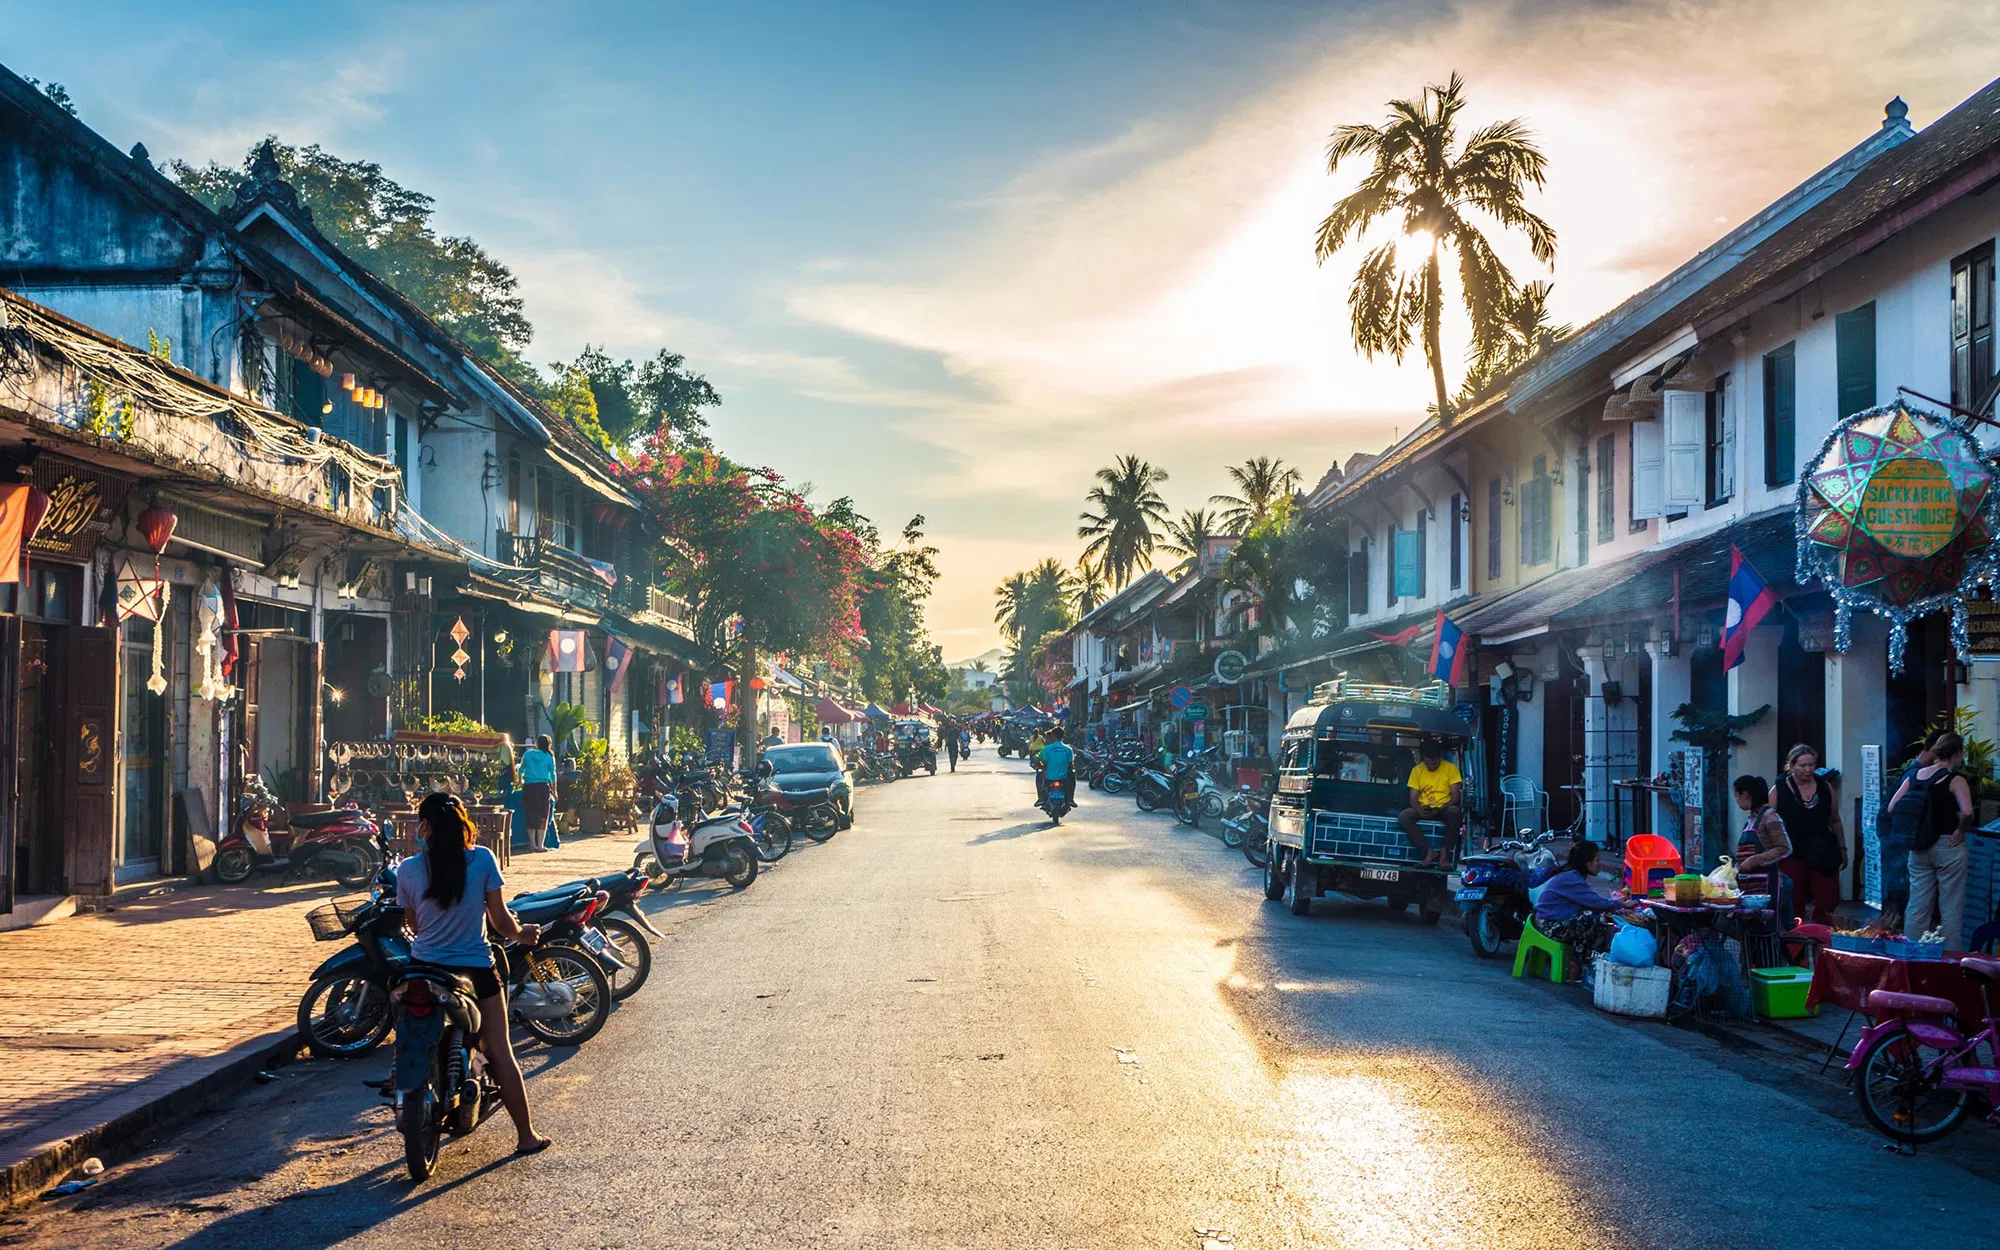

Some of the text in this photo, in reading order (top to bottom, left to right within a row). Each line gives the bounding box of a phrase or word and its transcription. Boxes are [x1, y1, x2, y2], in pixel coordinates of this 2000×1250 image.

[1866, 507, 1953, 525] GUESTHOUSE
[1502, 708, 1510, 736] ROOM
[1376, 870, 1397, 880] 0748
